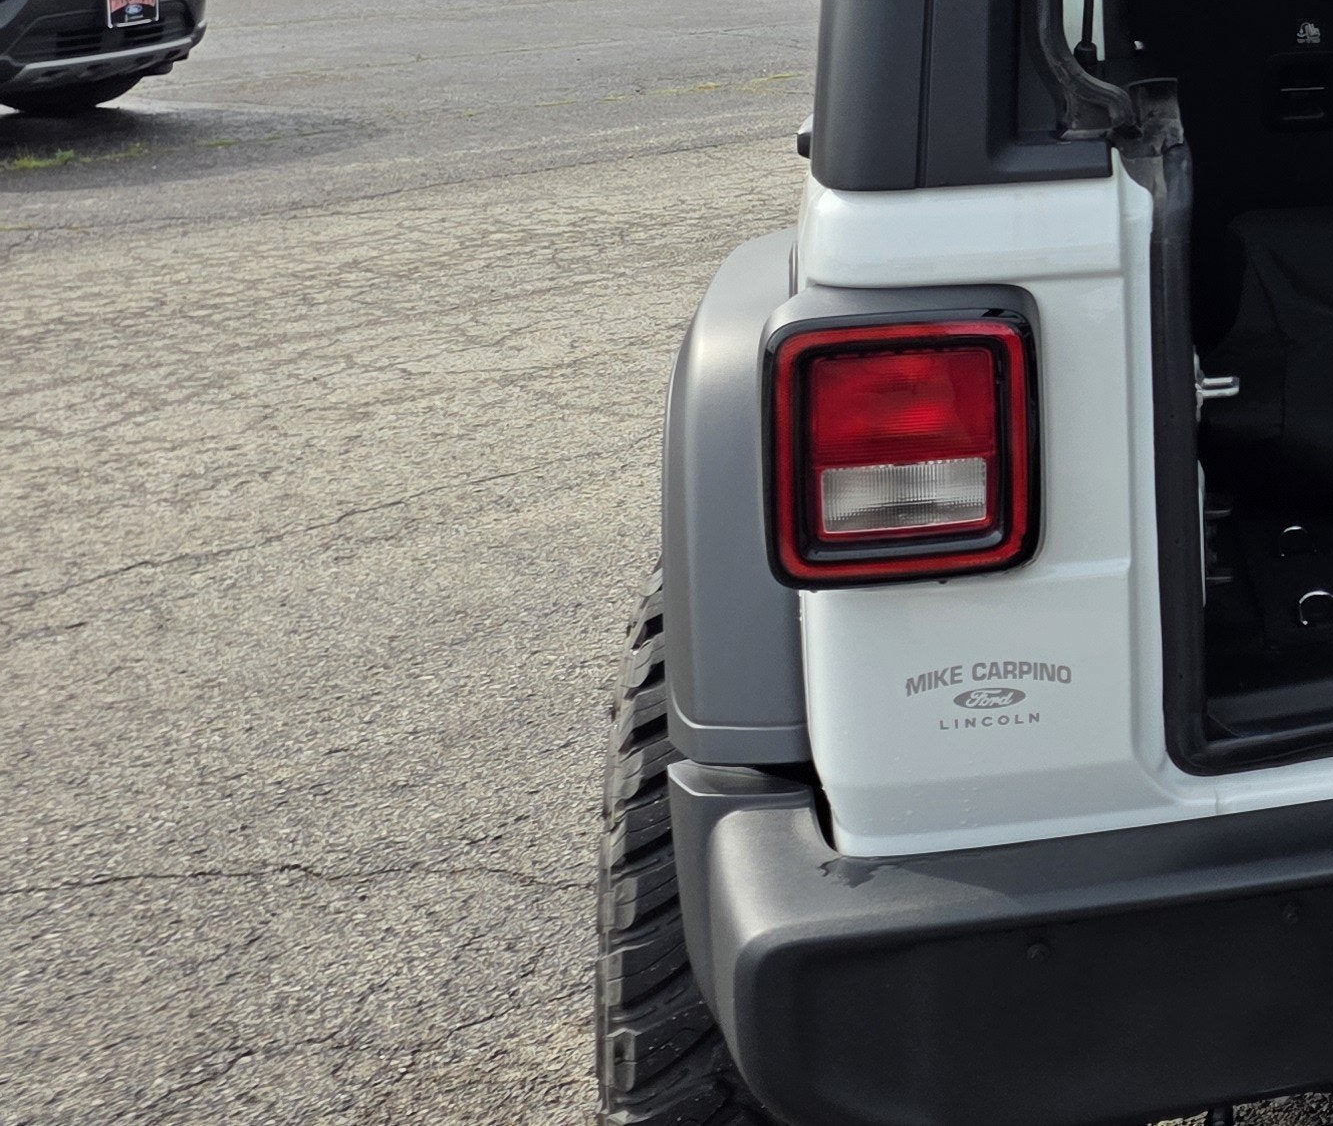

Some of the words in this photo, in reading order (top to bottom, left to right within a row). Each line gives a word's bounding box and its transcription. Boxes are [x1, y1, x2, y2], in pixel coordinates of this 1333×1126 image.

[905, 665, 963, 697] MIKE
[971, 661, 1072, 684] CARPINO
[965, 689, 1014, 708] Ford
[939, 712, 1040, 731] LINCOLN
